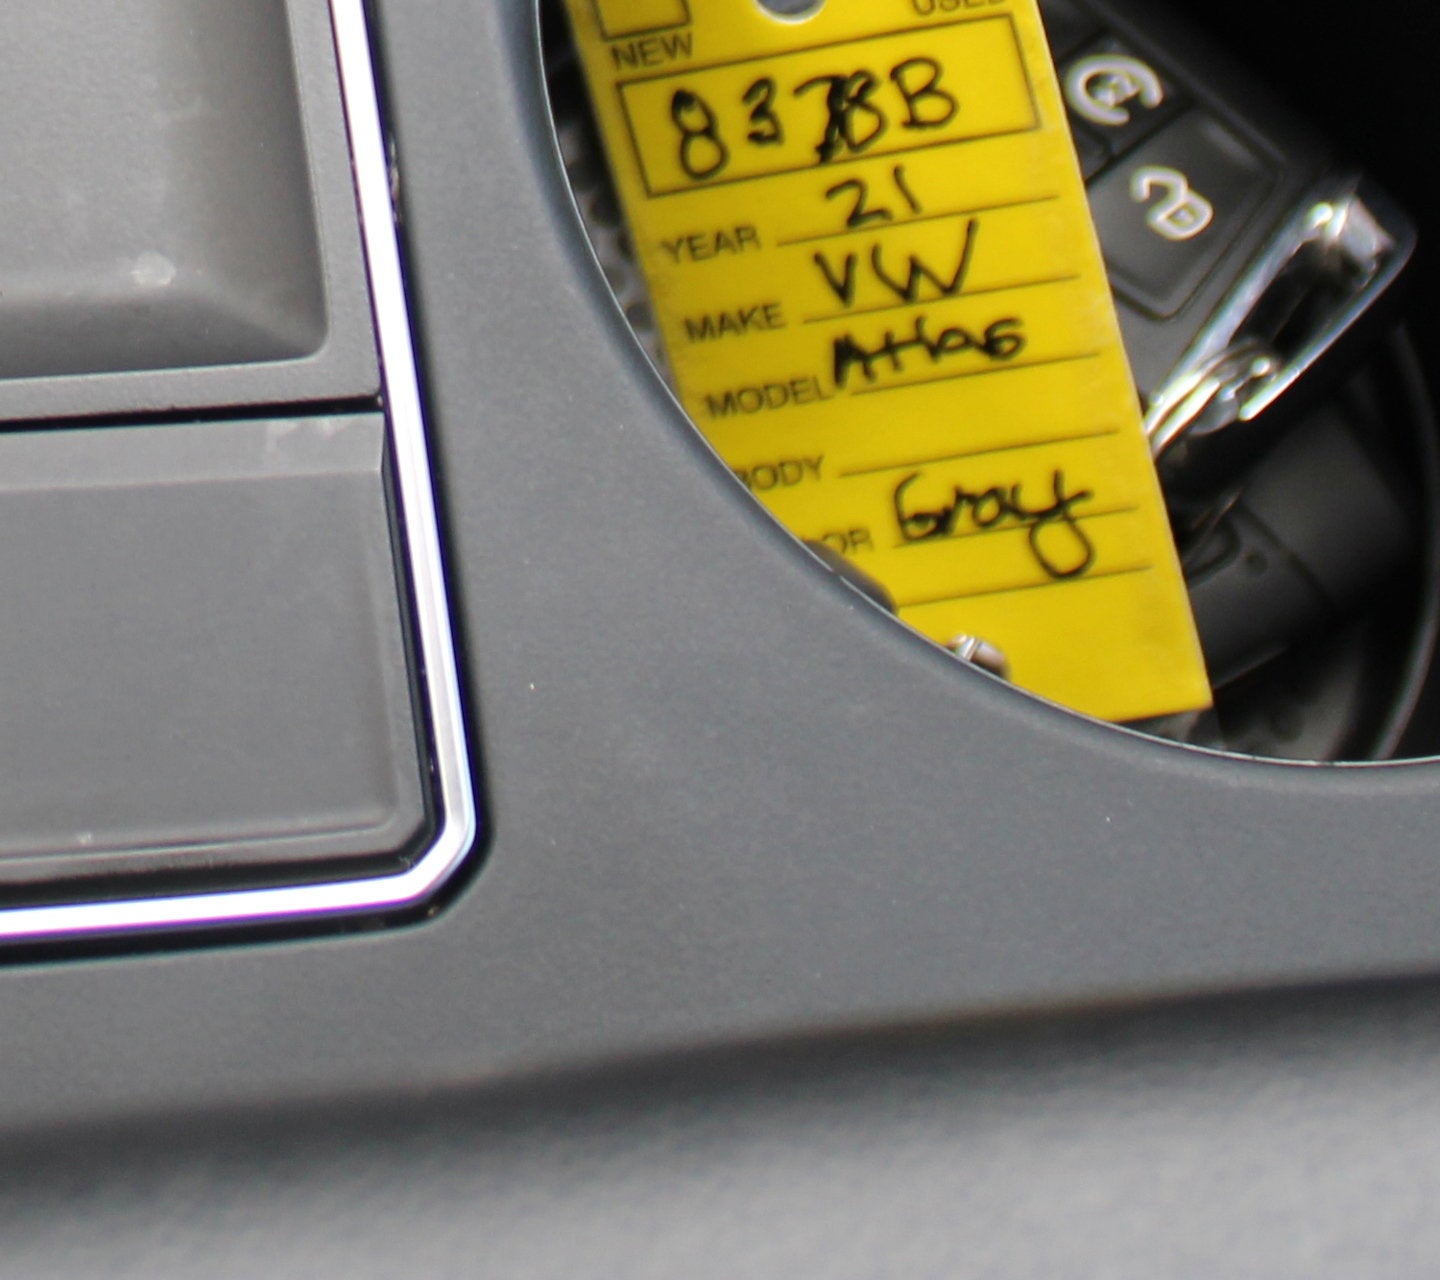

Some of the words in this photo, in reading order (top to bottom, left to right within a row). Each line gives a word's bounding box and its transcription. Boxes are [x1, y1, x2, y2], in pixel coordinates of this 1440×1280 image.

[610, 32, 693, 70] NEW
[825, 165, 921, 227] 21
[661, 223, 761, 264] YEAR
[814, 219, 978, 308] VW
[683, 304, 786, 344] MAKE
[705, 377, 834, 420] MODEL
